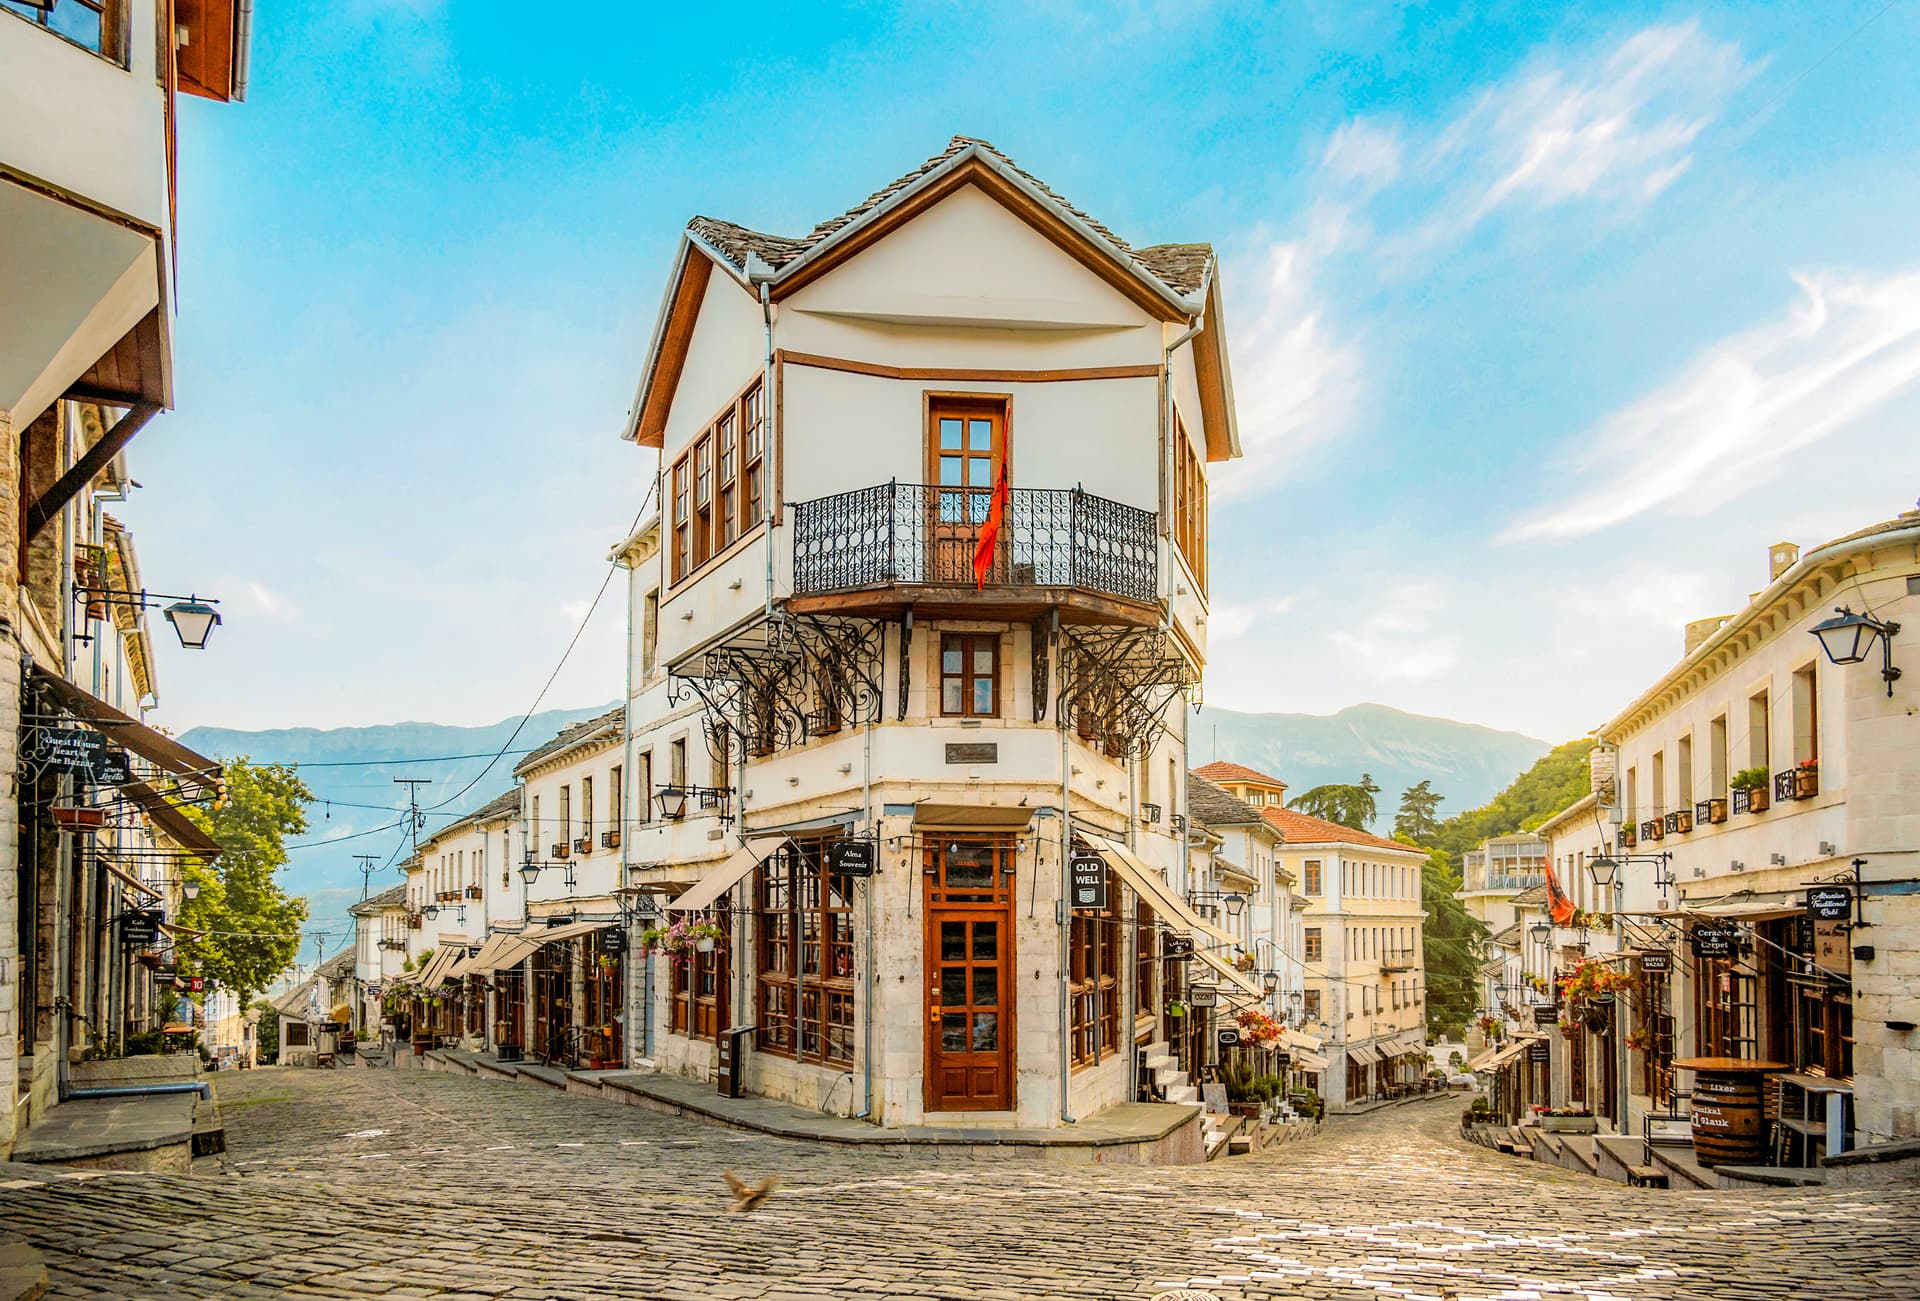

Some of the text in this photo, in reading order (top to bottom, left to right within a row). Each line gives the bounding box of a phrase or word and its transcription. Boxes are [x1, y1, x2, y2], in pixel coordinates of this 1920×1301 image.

[844, 850, 862, 858] Alma
[839, 860, 868, 868] Souvenir
[1076, 863, 1099, 872] OLD
[1075, 875, 1100, 885] WELL
[1811, 891, 1845, 900] Albanian
[1811, 900, 1847, 908] Traditional
[193, 980, 203, 990] 10
